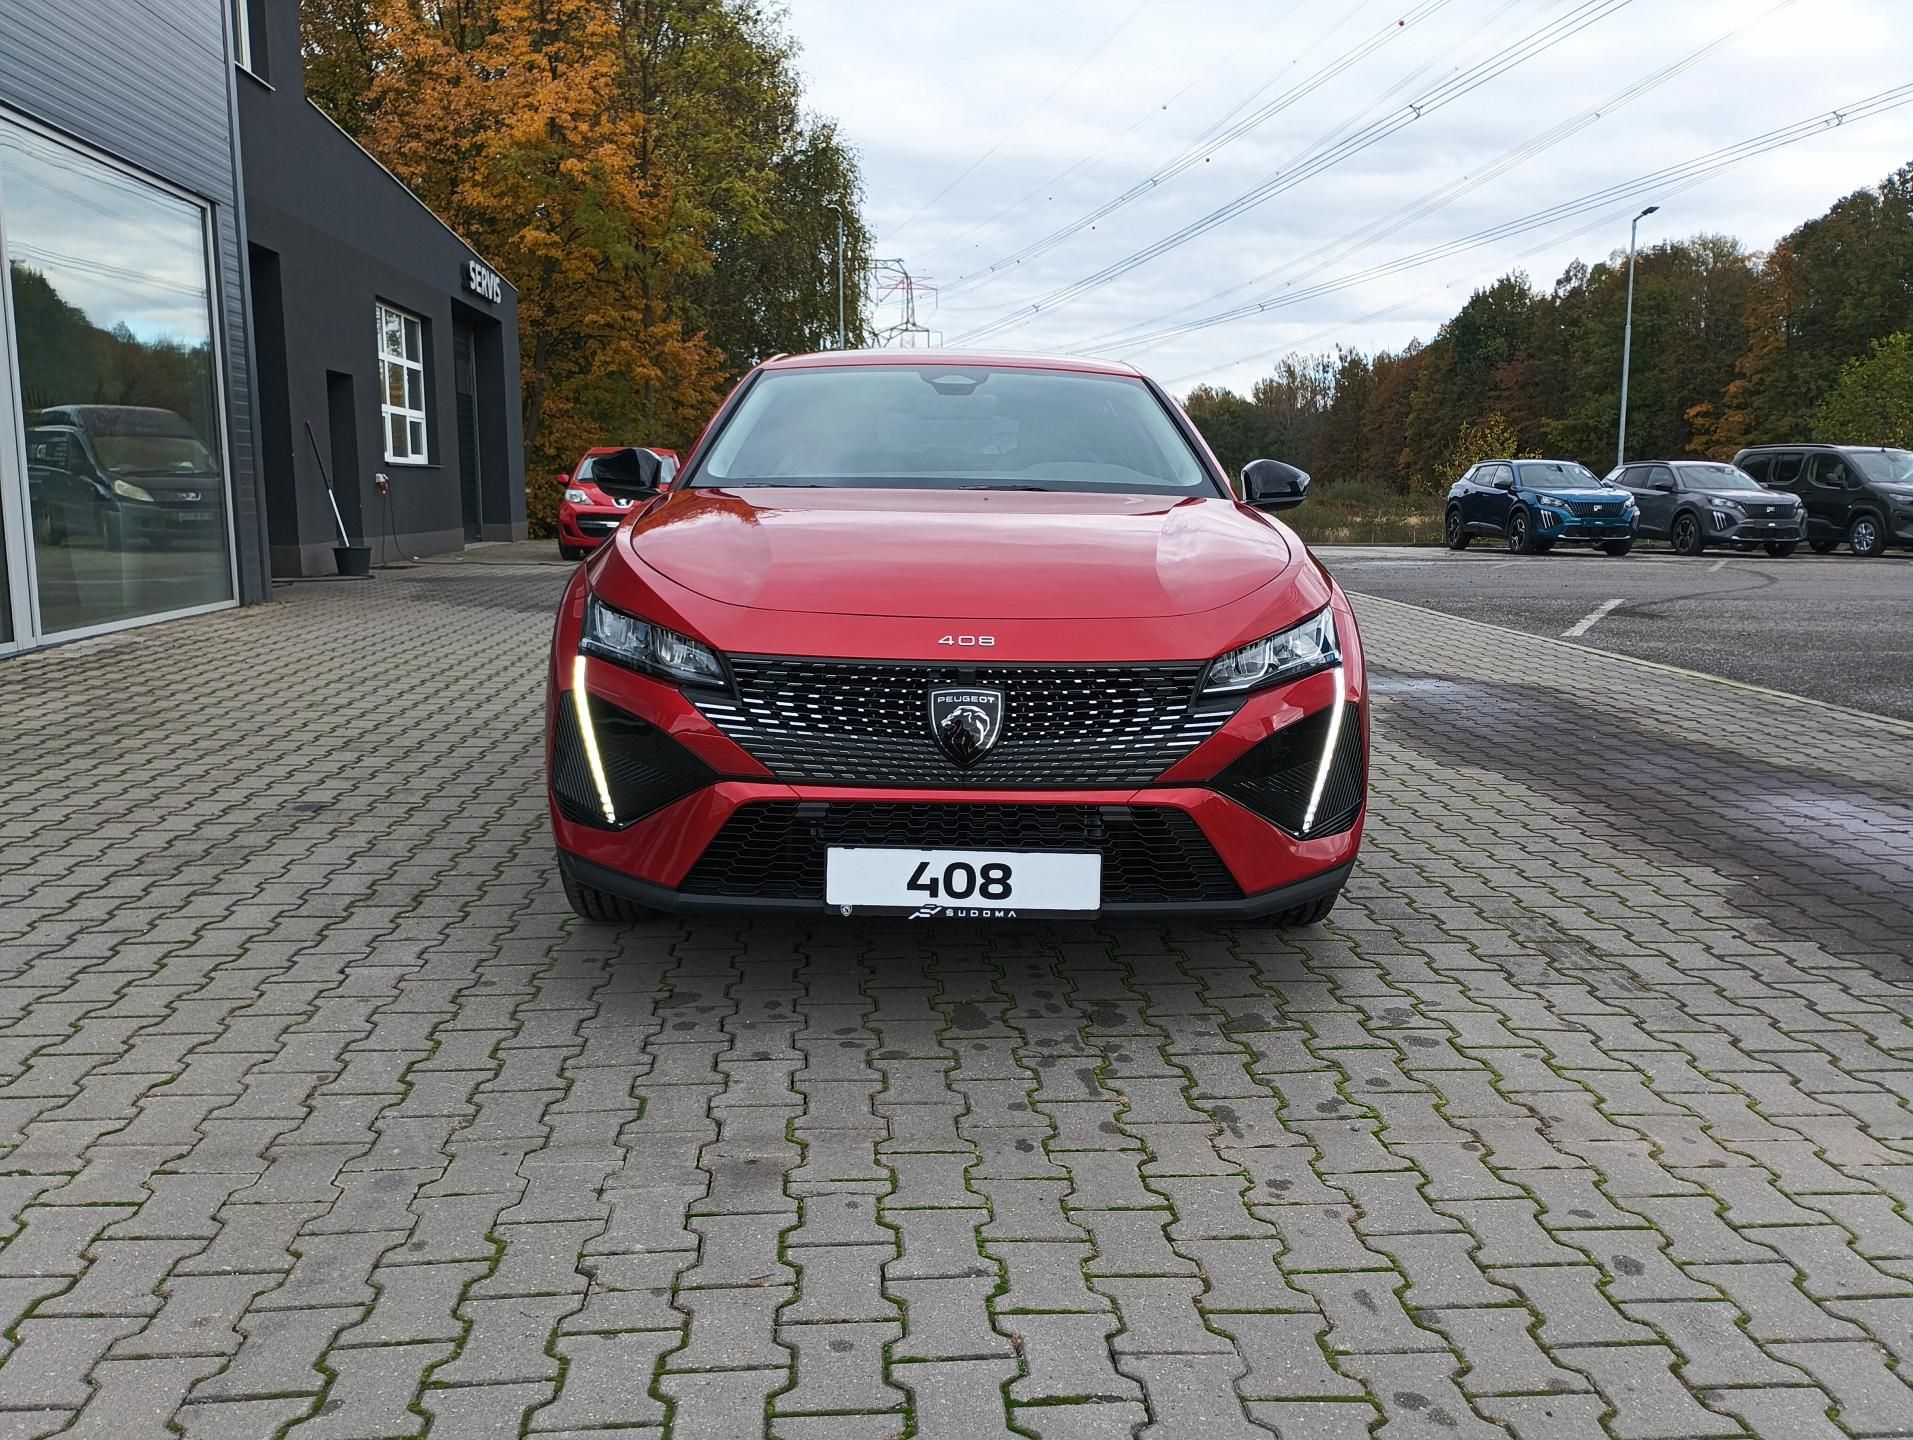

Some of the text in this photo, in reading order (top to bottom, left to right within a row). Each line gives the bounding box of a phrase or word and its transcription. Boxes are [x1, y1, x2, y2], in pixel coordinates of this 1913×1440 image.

[469, 260, 502, 304] SERVIS
[937, 635, 996, 646] 408
[937, 695, 996, 704] PEUGEOT
[906, 861, 1013, 900] 408
[945, 908, 1017, 918] SUDOMA
